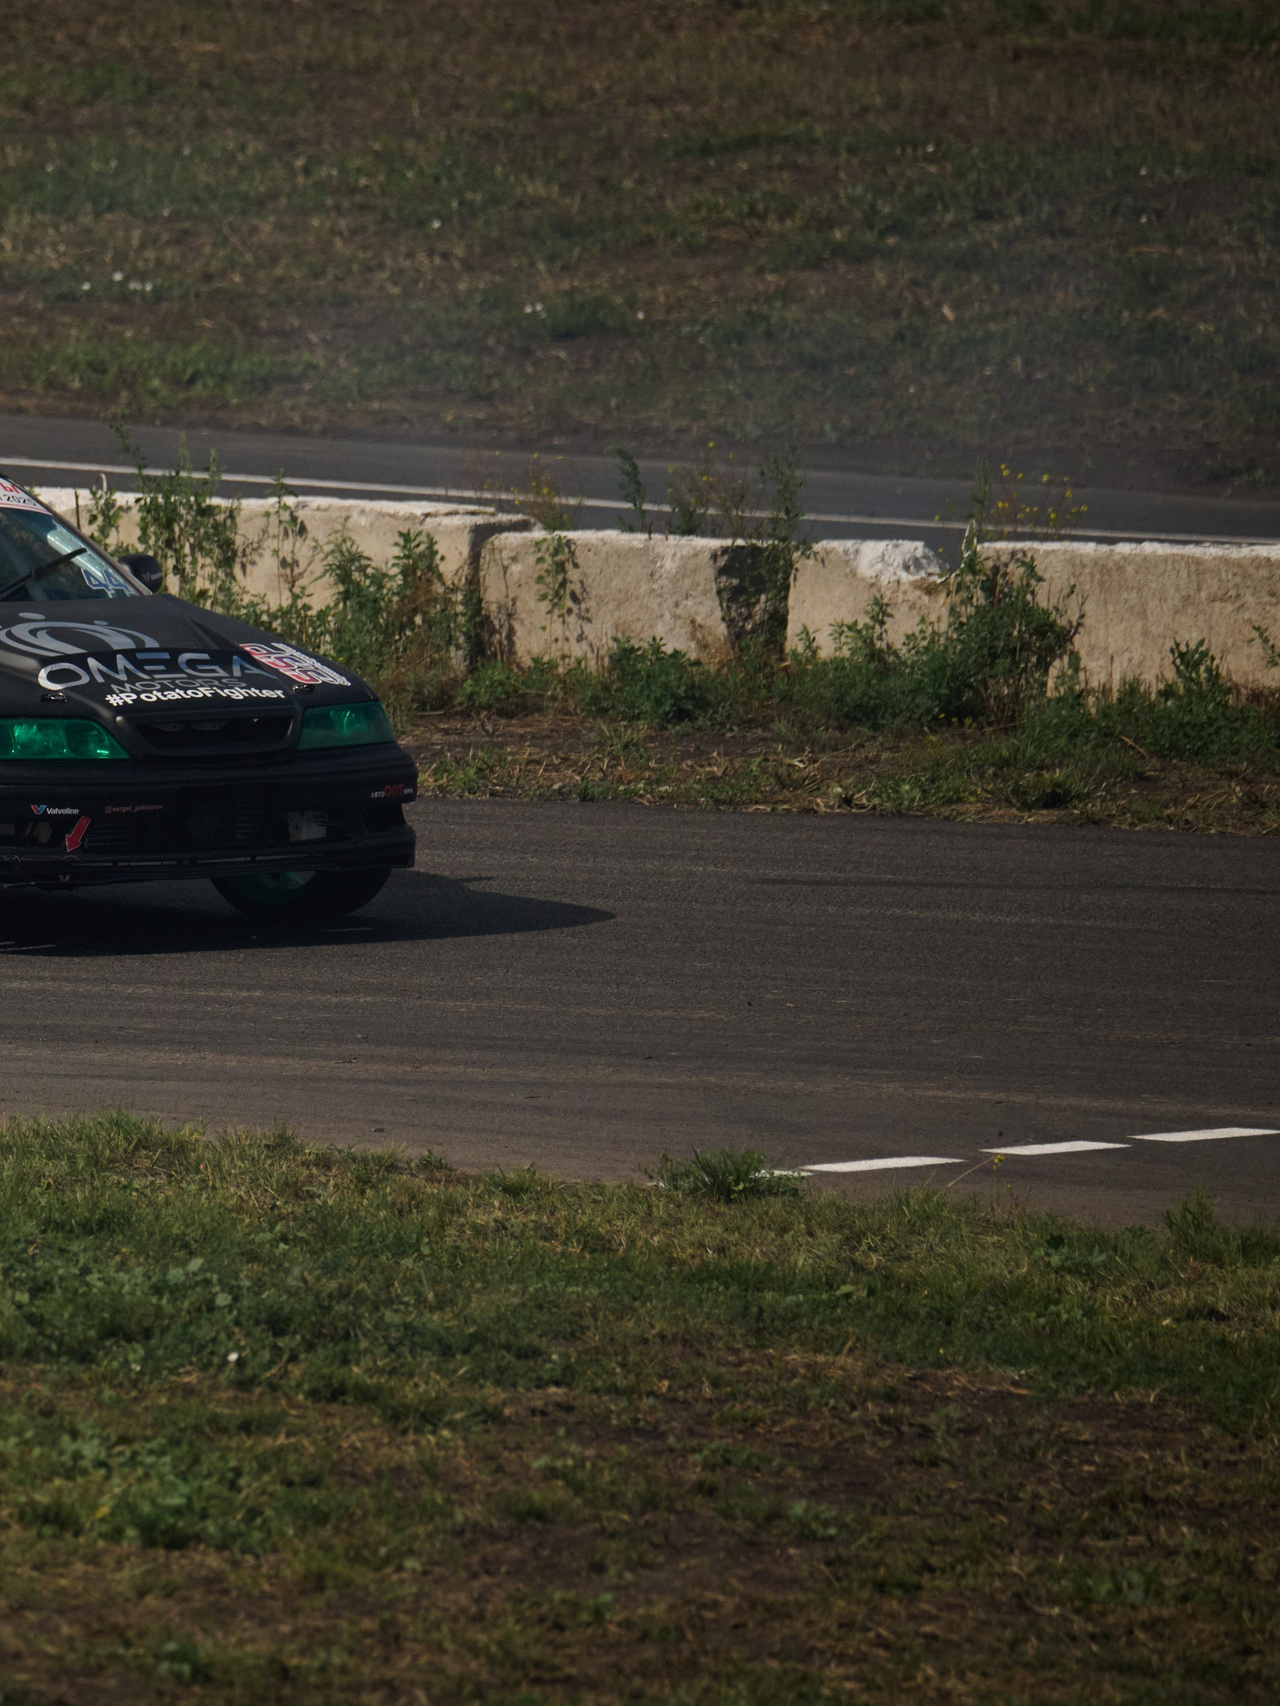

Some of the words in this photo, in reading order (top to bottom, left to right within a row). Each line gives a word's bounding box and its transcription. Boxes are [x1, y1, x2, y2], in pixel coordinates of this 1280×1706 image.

[38, 652, 278, 690] OMEGA
[111, 678, 248, 693] MOTORS
[105, 686, 286, 706] #PotatoFighter
[46, 807, 80, 815] Valvoline
